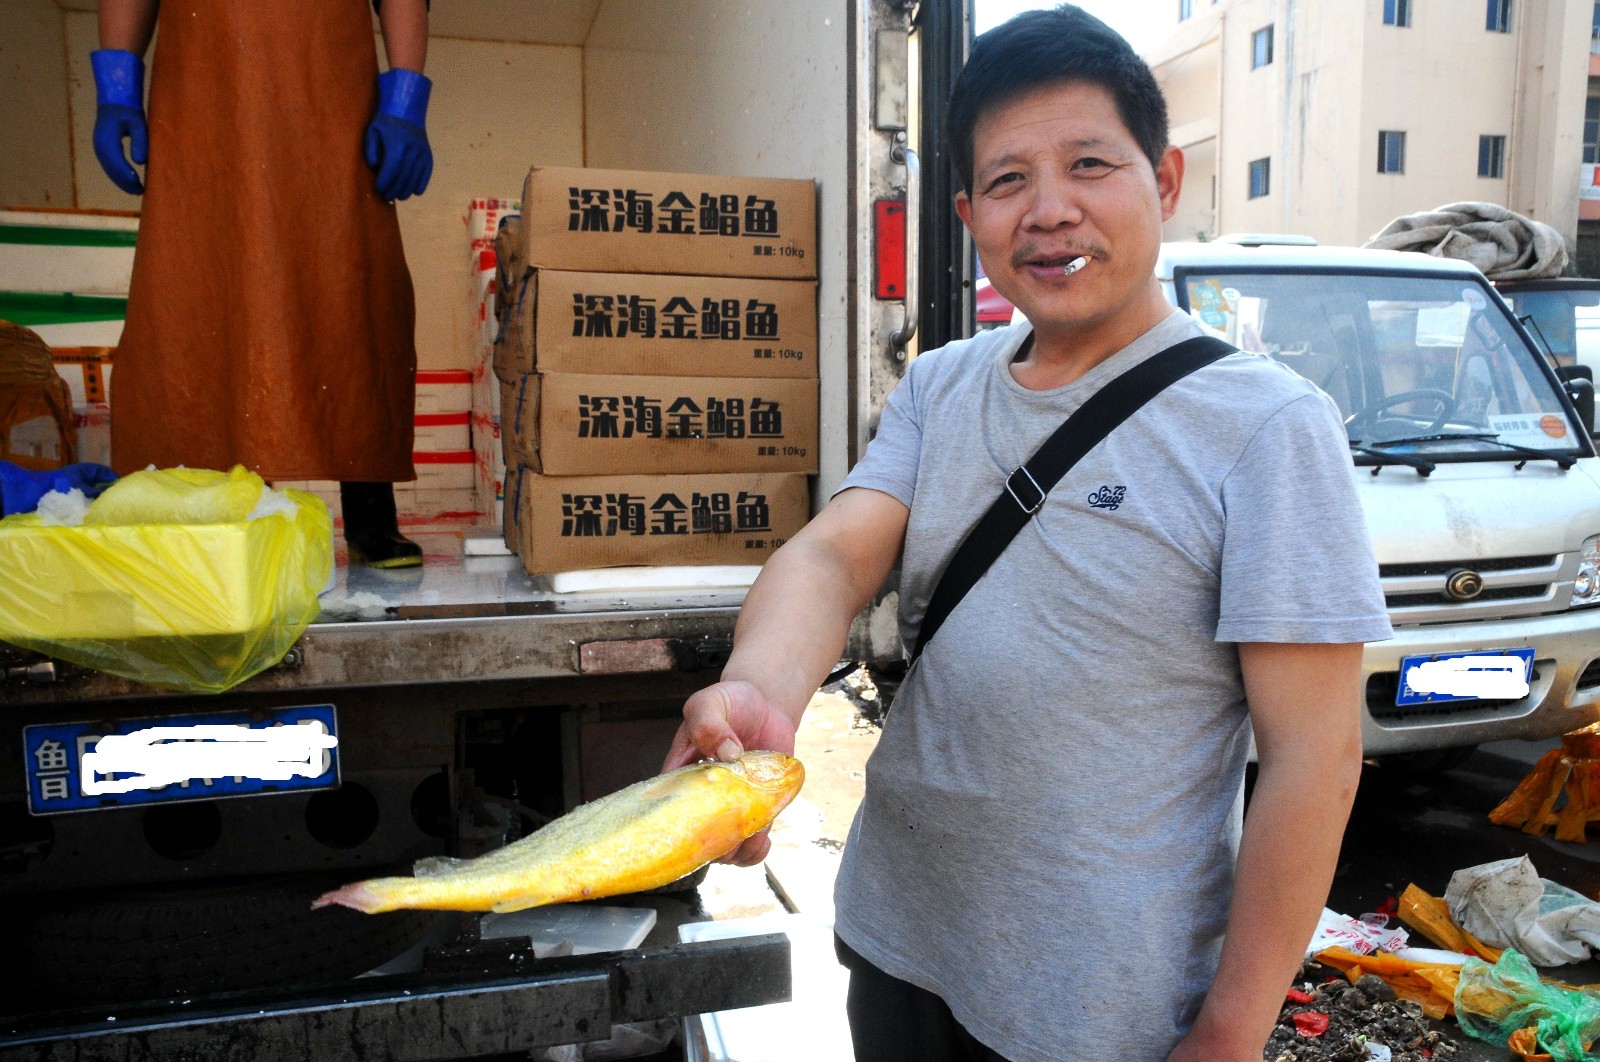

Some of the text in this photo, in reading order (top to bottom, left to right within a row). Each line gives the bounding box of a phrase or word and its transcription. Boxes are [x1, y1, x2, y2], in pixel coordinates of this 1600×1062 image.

[568, 187, 781, 239] 深海金鲳鱼
[779, 246, 805, 259] 10kg
[572, 293, 781, 341] 深海金鲳鱼
[778, 349, 803, 360] 10kg
[578, 394, 785, 439] 深海金鲳鱼
[782, 446, 806, 458] 10kg
[561, 491, 773, 538] 深海金鲳鱼
[1088, 486, 1125, 511] Stage
